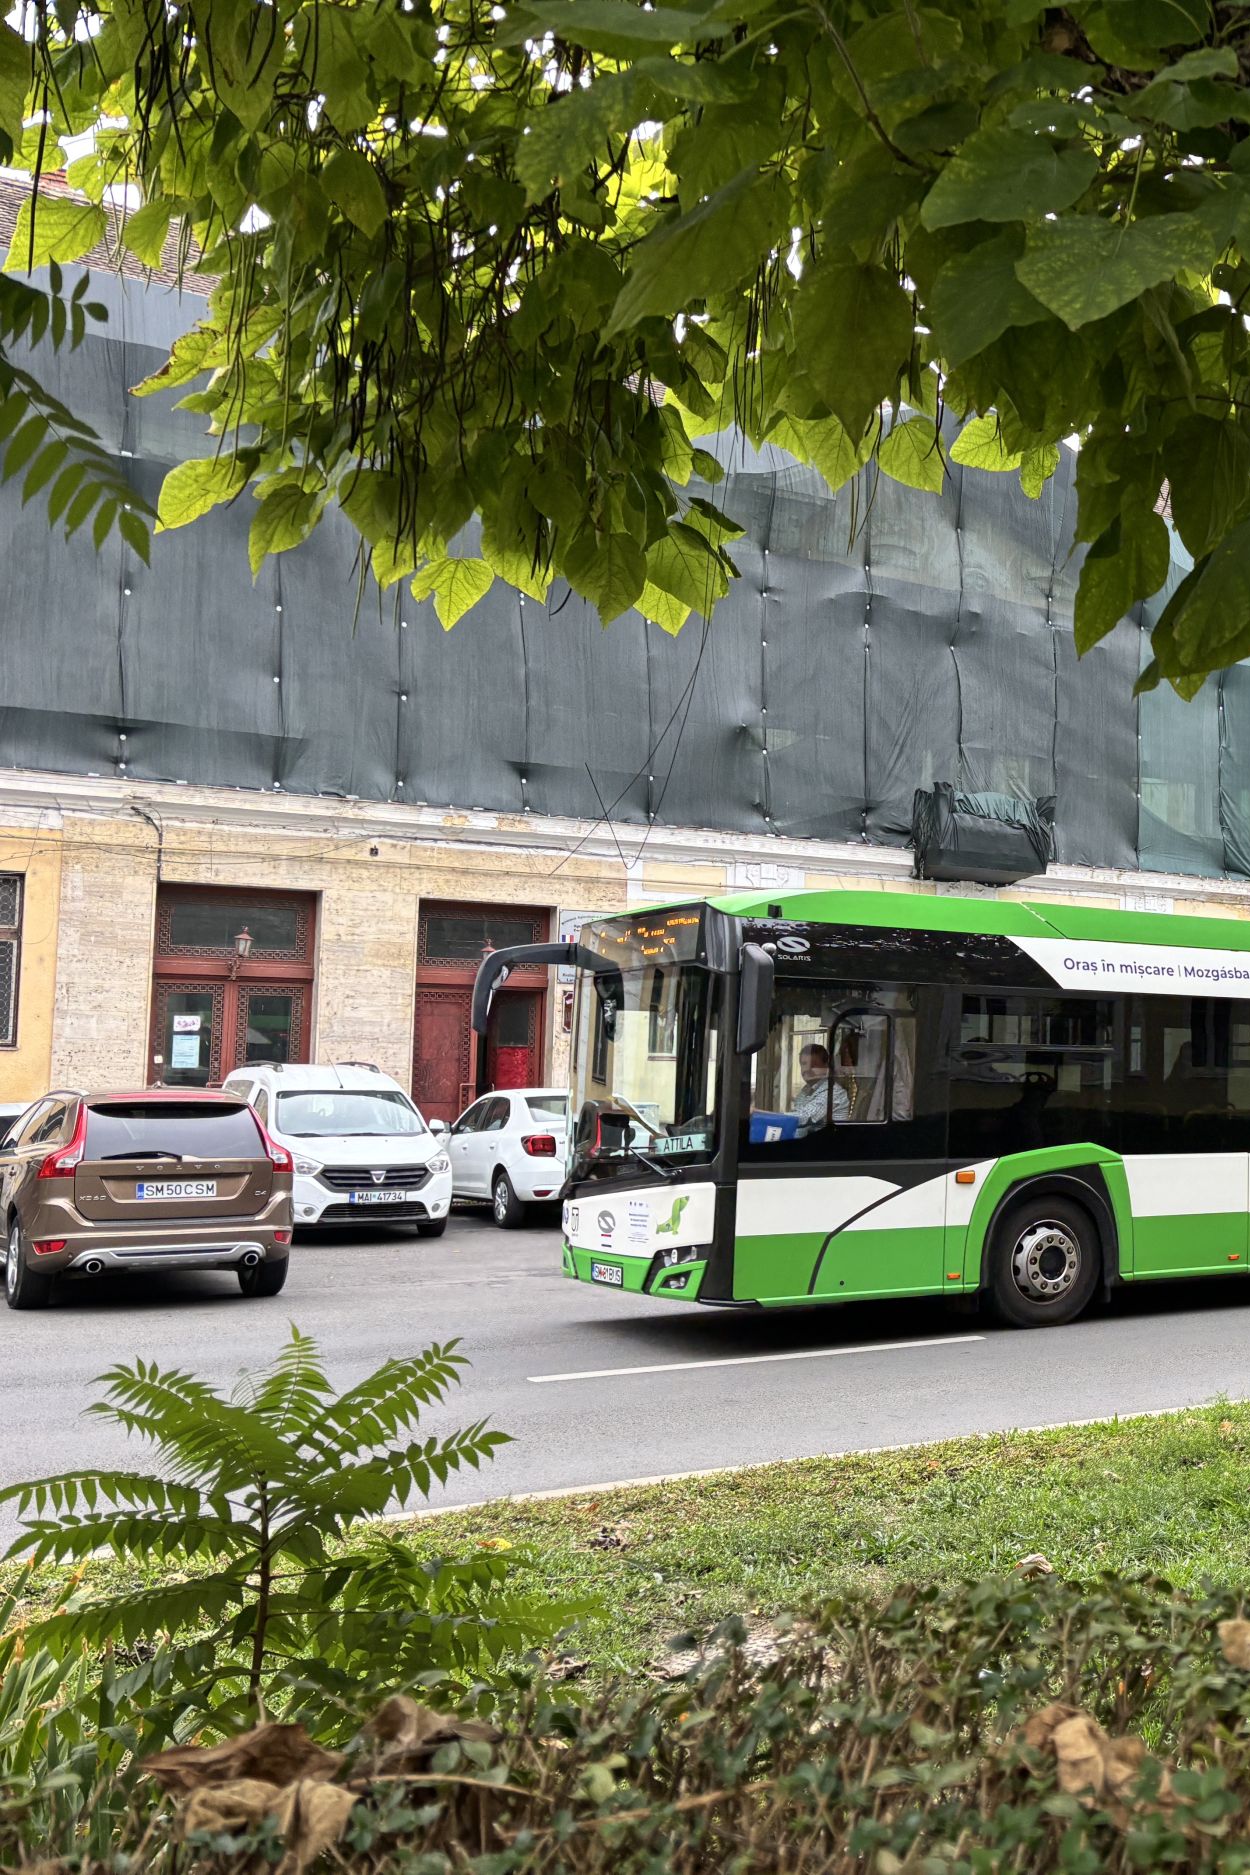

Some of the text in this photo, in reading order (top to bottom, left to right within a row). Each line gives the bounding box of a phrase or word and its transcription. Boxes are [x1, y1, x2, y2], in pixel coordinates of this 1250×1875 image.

[1063, 957, 1098, 976] Oraș
[1101, 959, 1115, 973] în
[1119, 961, 1175, 979] mișcare
[663, 1136, 693, 1152] ATTILA
